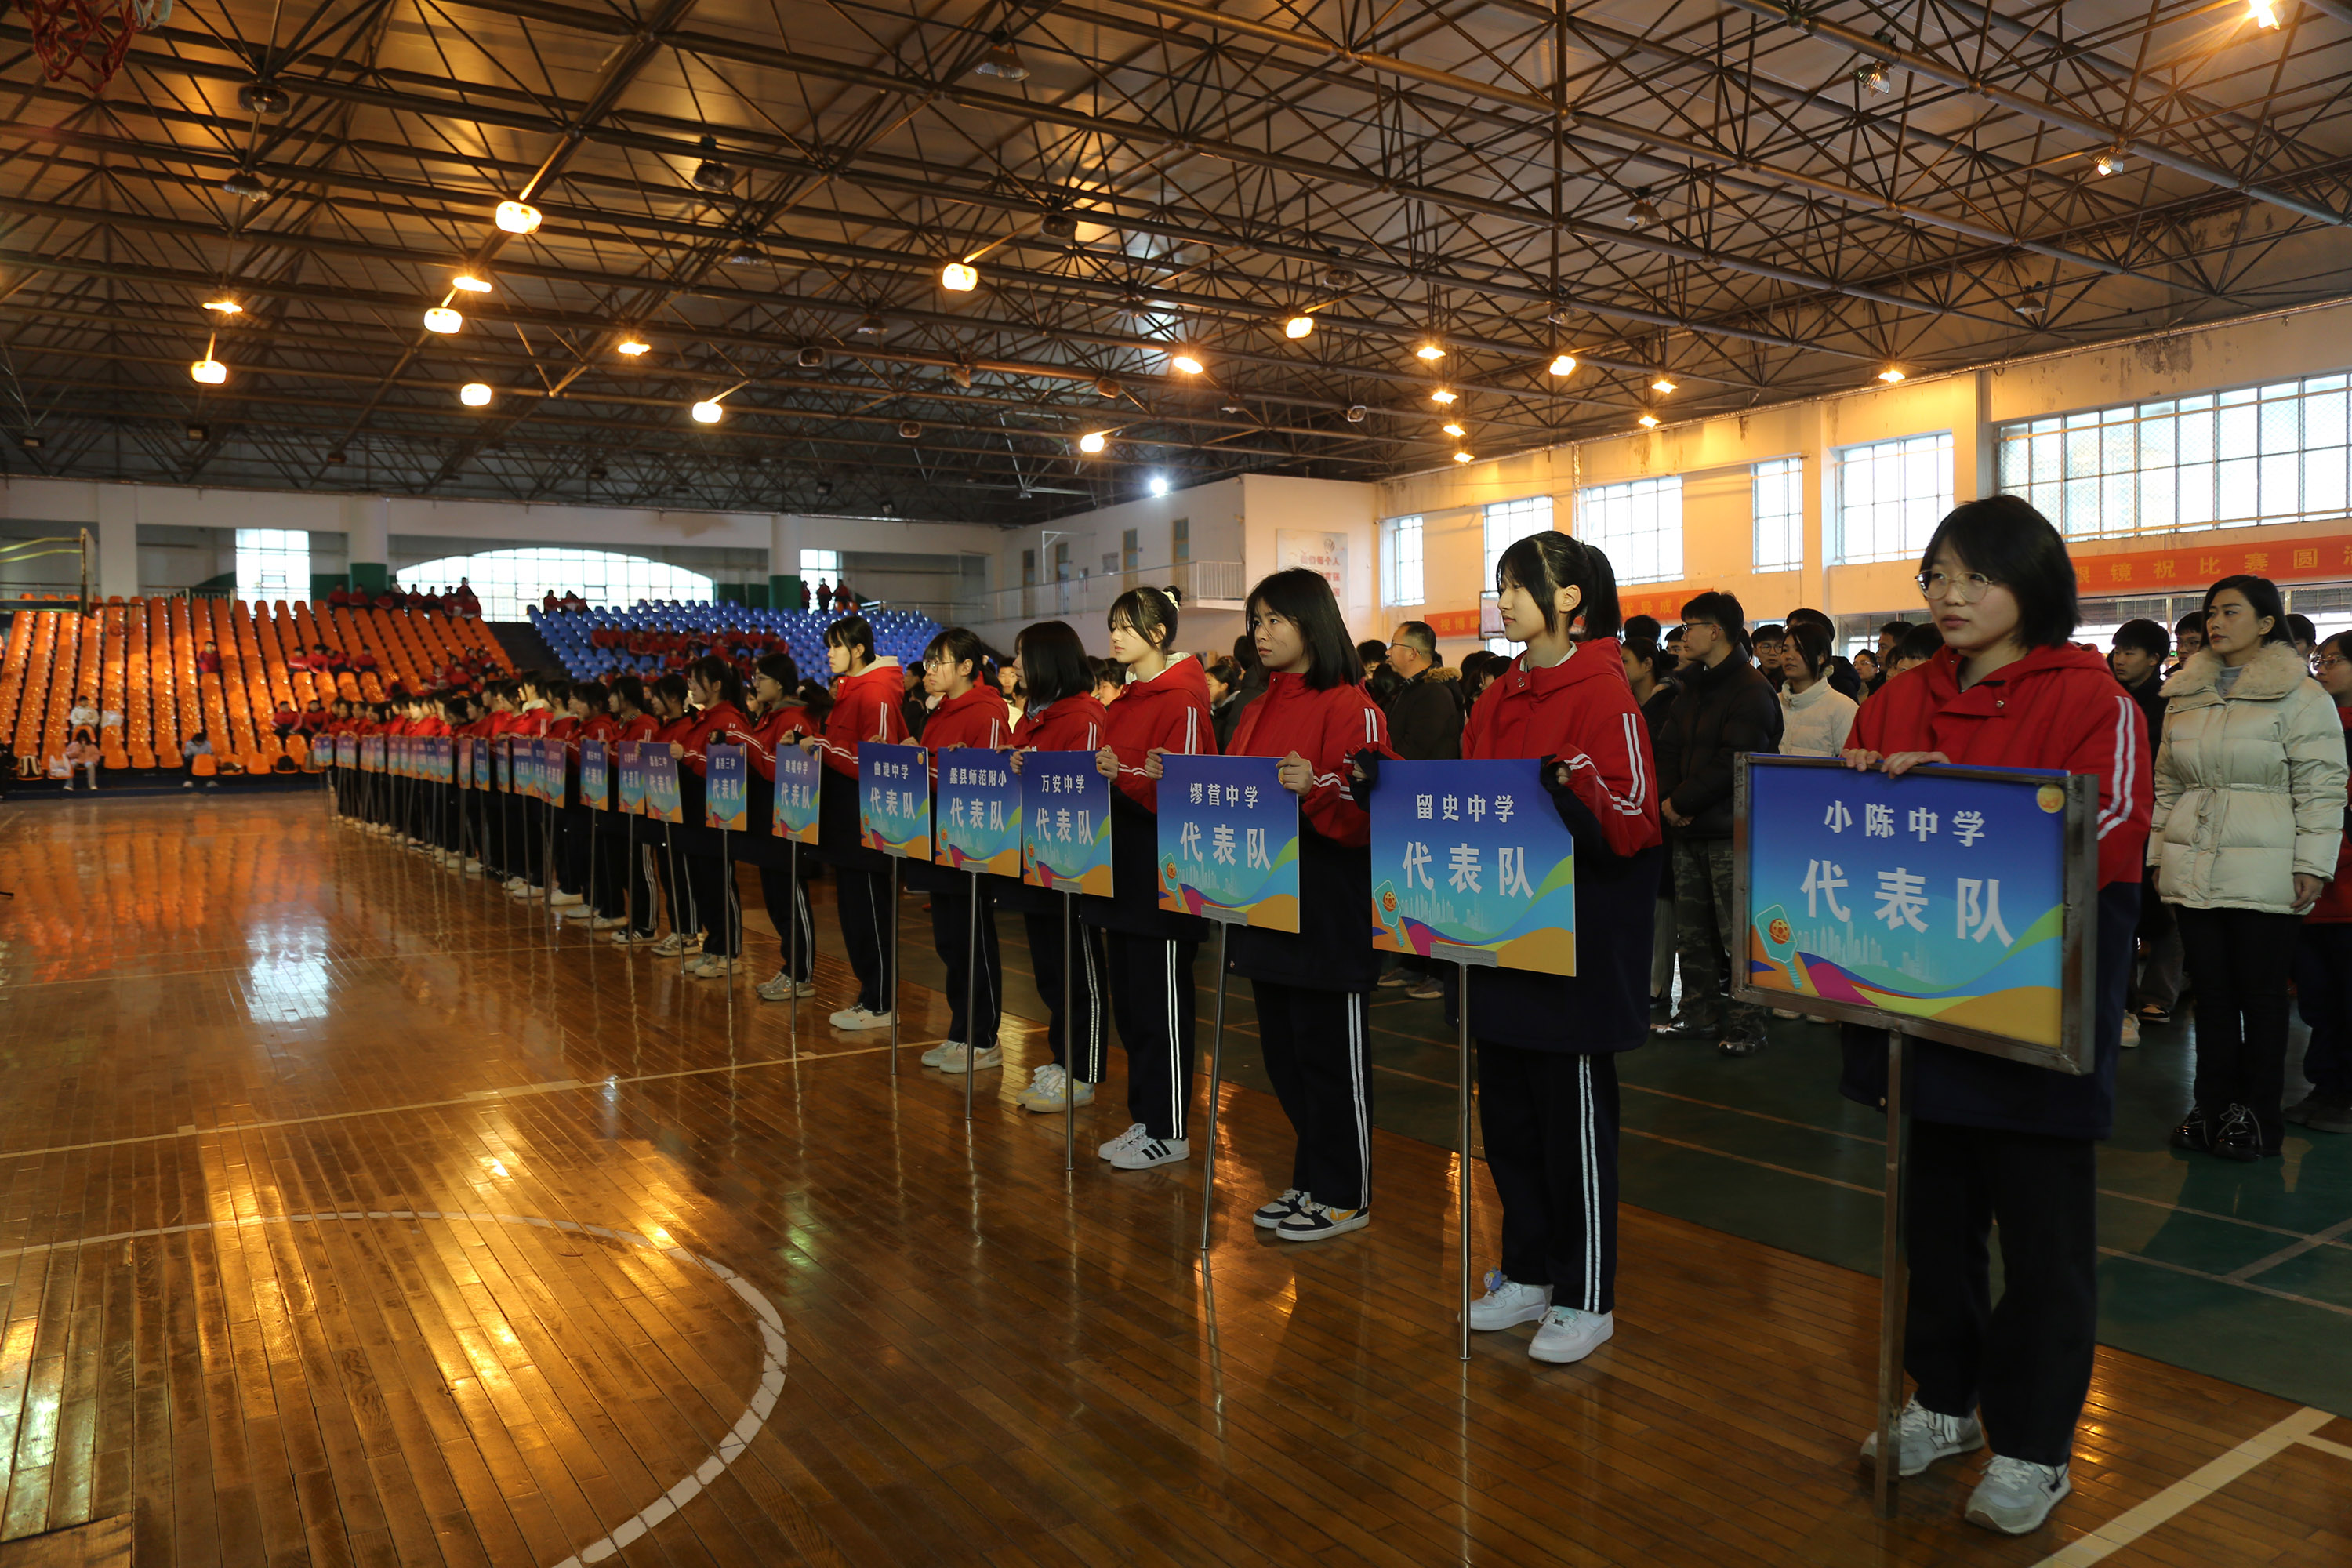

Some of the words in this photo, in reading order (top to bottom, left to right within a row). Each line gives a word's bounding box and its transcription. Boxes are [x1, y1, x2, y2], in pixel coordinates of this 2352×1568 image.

[649, 774, 673, 796] 代表队
[712, 778, 739, 800] 代表队
[949, 768, 1007, 787] 蠡县师范附小
[1041, 774, 1085, 794] 万安中学
[781, 782, 811, 809] 代表队
[869, 787, 916, 820] 代表队
[1190, 782, 1258, 809] 缪营中学
[1416, 793, 1515, 823] 留史中学
[950, 797, 1004, 833] 代表队
[1036, 808, 1094, 846] 代表队
[1824, 800, 1986, 847] 小陈中学
[1180, 822, 1272, 871] 代表队
[1402, 841, 1534, 899] 代表队
[1801, 859, 2015, 948] 代表队
